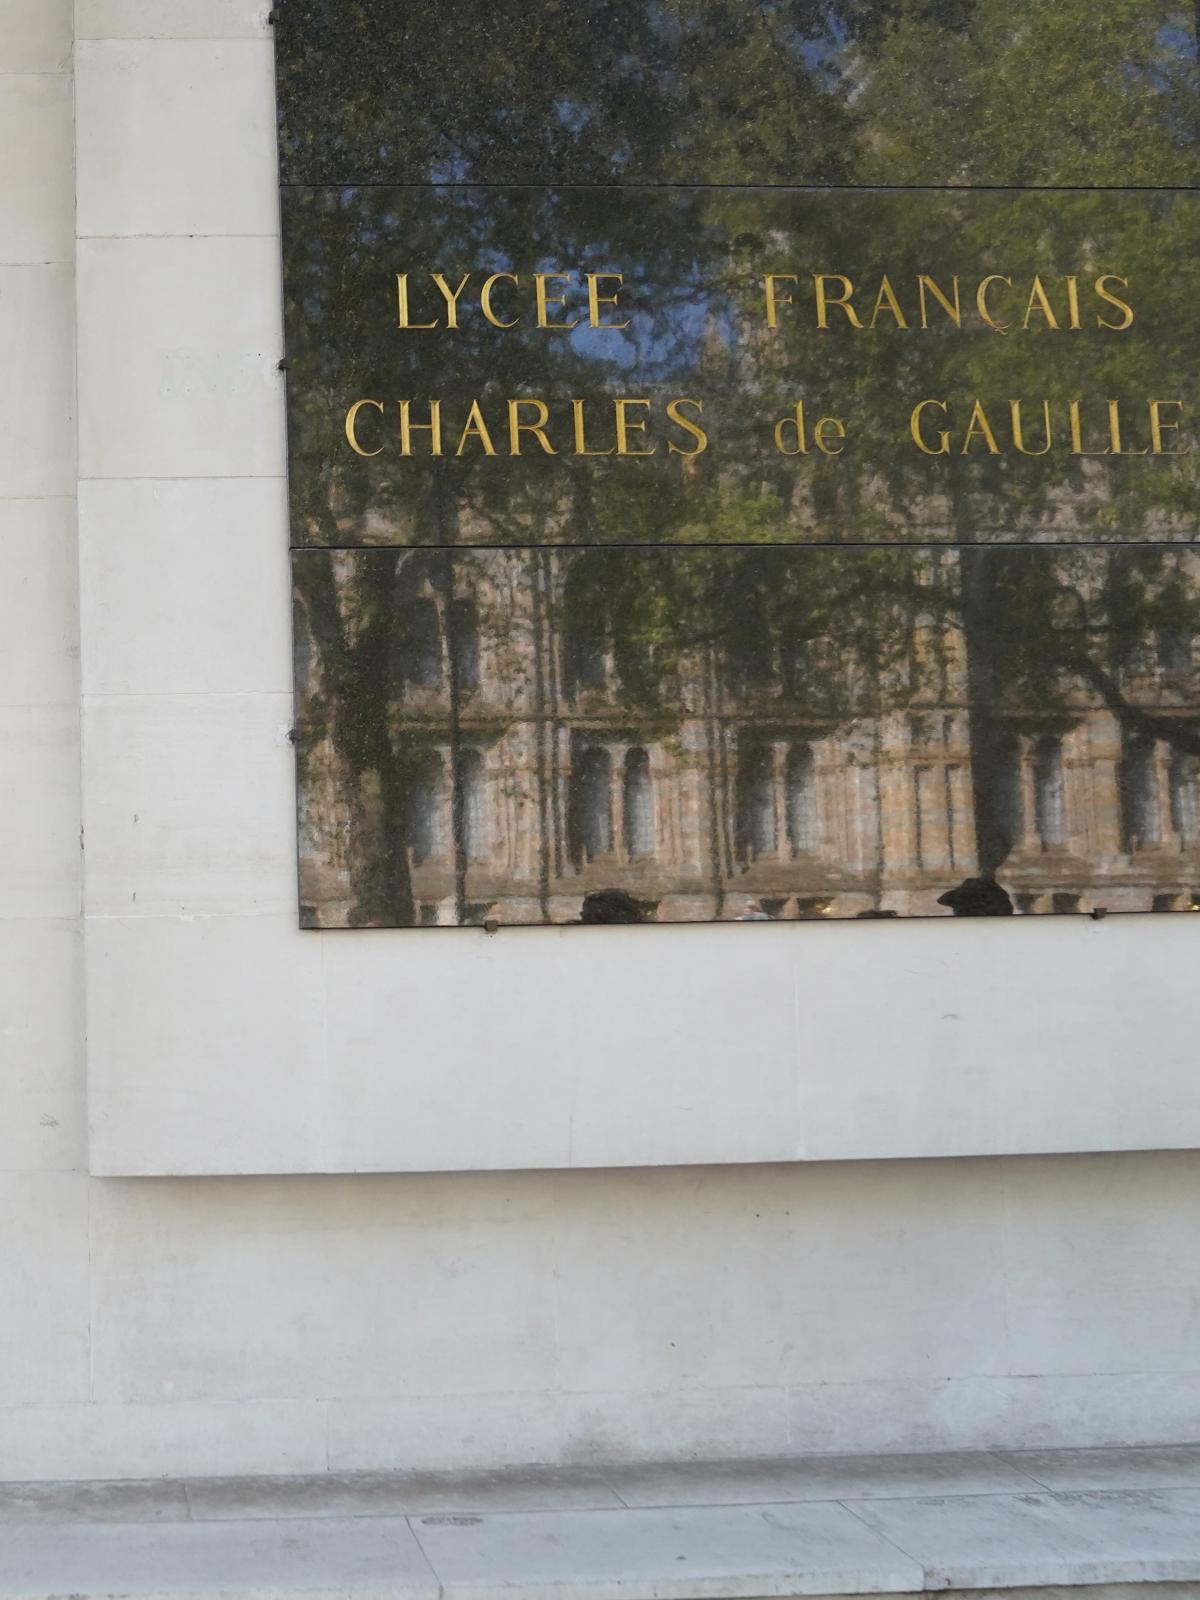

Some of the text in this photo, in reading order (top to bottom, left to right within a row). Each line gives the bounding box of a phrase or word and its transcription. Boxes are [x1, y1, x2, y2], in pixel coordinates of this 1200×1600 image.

[396, 273, 1134, 335] LYCEE FRANÇAIS
[345, 399, 1191, 457] CHARLES de GAULLE
